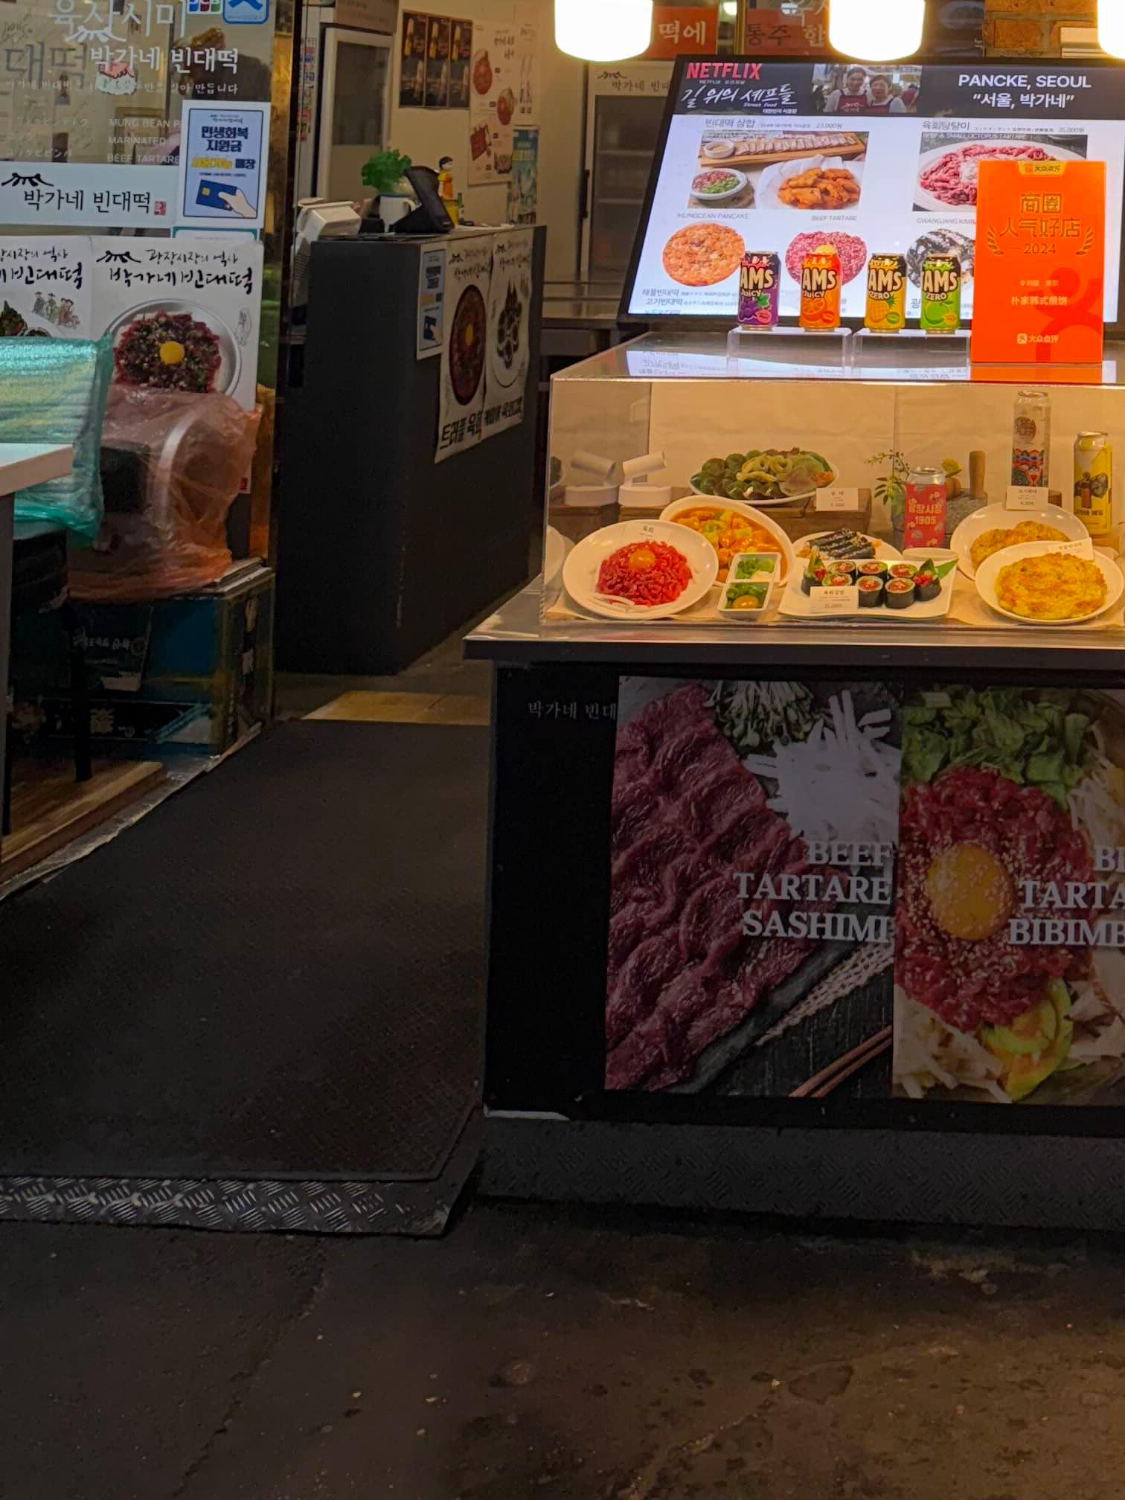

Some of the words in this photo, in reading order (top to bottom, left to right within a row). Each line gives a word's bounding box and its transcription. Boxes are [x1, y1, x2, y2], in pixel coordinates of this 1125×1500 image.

[90, 45, 161, 72] 박가네
[171, 48, 239, 75] 빈대떡
[686, 62, 763, 80] NETFLIX
[958, 73, 1031, 91] PANCKE,
[1035, 75, 1092, 89] SEOUL
[681, 85, 706, 109] 길
[704, 86, 740, 104] 위의
[142, 118, 170, 129] BEAN
[201, 124, 250, 140] 민생회복
[206, 138, 243, 153] 지원금
[24, 188, 85, 213] 박가네
[93, 190, 151, 215] 빈대떡
[1021, 193, 1062, 214] 商圈
[1000, 217, 1081, 238] 人气好店
[1024, 243, 1056, 255] 2024
[740, 266, 774, 291] AMS
[802, 268, 838, 292] AMS
[868, 268, 903, 293] AMS
[921, 269, 958, 294] AMS
[807, 840, 891, 868] BEEF
[734, 873, 891, 905] TARTARE
[742, 911, 891, 944] SASHIMI
